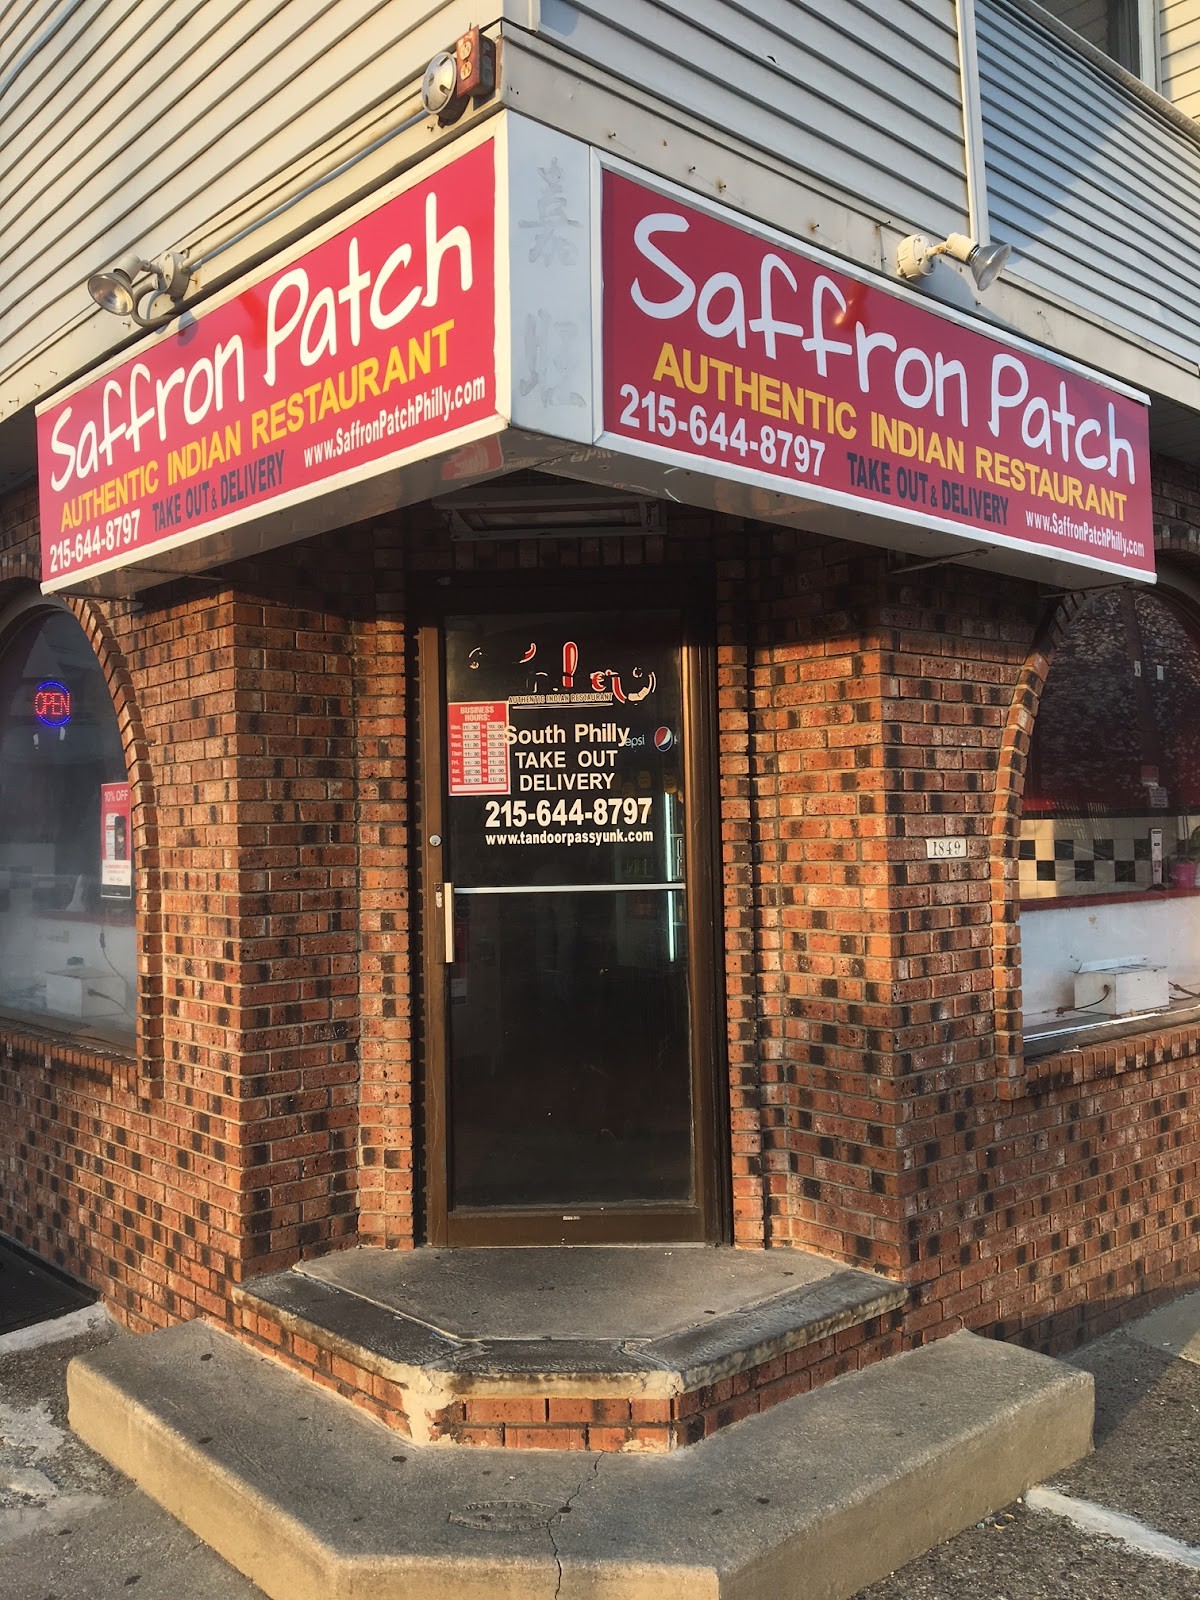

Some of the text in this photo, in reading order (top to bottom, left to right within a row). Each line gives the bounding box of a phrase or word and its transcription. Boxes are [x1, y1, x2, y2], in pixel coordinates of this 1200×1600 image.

[51, 334, 245, 492] Saffron
[263, 192, 473, 387] Patch
[630, 213, 969, 427] Saffron
[987, 353, 1135, 485] Patch
[61, 319, 455, 533] AUTHENTIC INDIAN RESTAURANT
[303, 375, 486, 468] www.SaffronPatchPhilly.com
[619, 383, 826, 477] 215-644-8797
[653, 342, 1127, 522] AUTHENTIC INDIAN RESTAURANT
[152, 449, 285, 532] TAKE OUT & DELIVERY
[847, 452, 1009, 525] TAKE OUT & DELIVERY
[50, 508, 141, 573] 215-644-8797
[1025, 510, 1145, 559] www.SaffronPatchPhilly.com
[35, 692, 70, 715] OPEN
[461, 706, 494, 715] BUSINESS
[546, 693, 570, 704] INDIAN
[570, 692, 614, 703] RESTAURANT
[465, 714, 491, 722] HOURS:
[505, 722, 630, 747] South Philly
[515, 750, 618, 769] TAKE OUT
[104, 789, 128, 802] 10% OFF
[519, 772, 615, 792] DELIVERY
[485, 797, 653, 828] 215-644-8797
[485, 828, 654, 847] www.tandoorpassyunk.com
[932, 840, 961, 856] 1849
